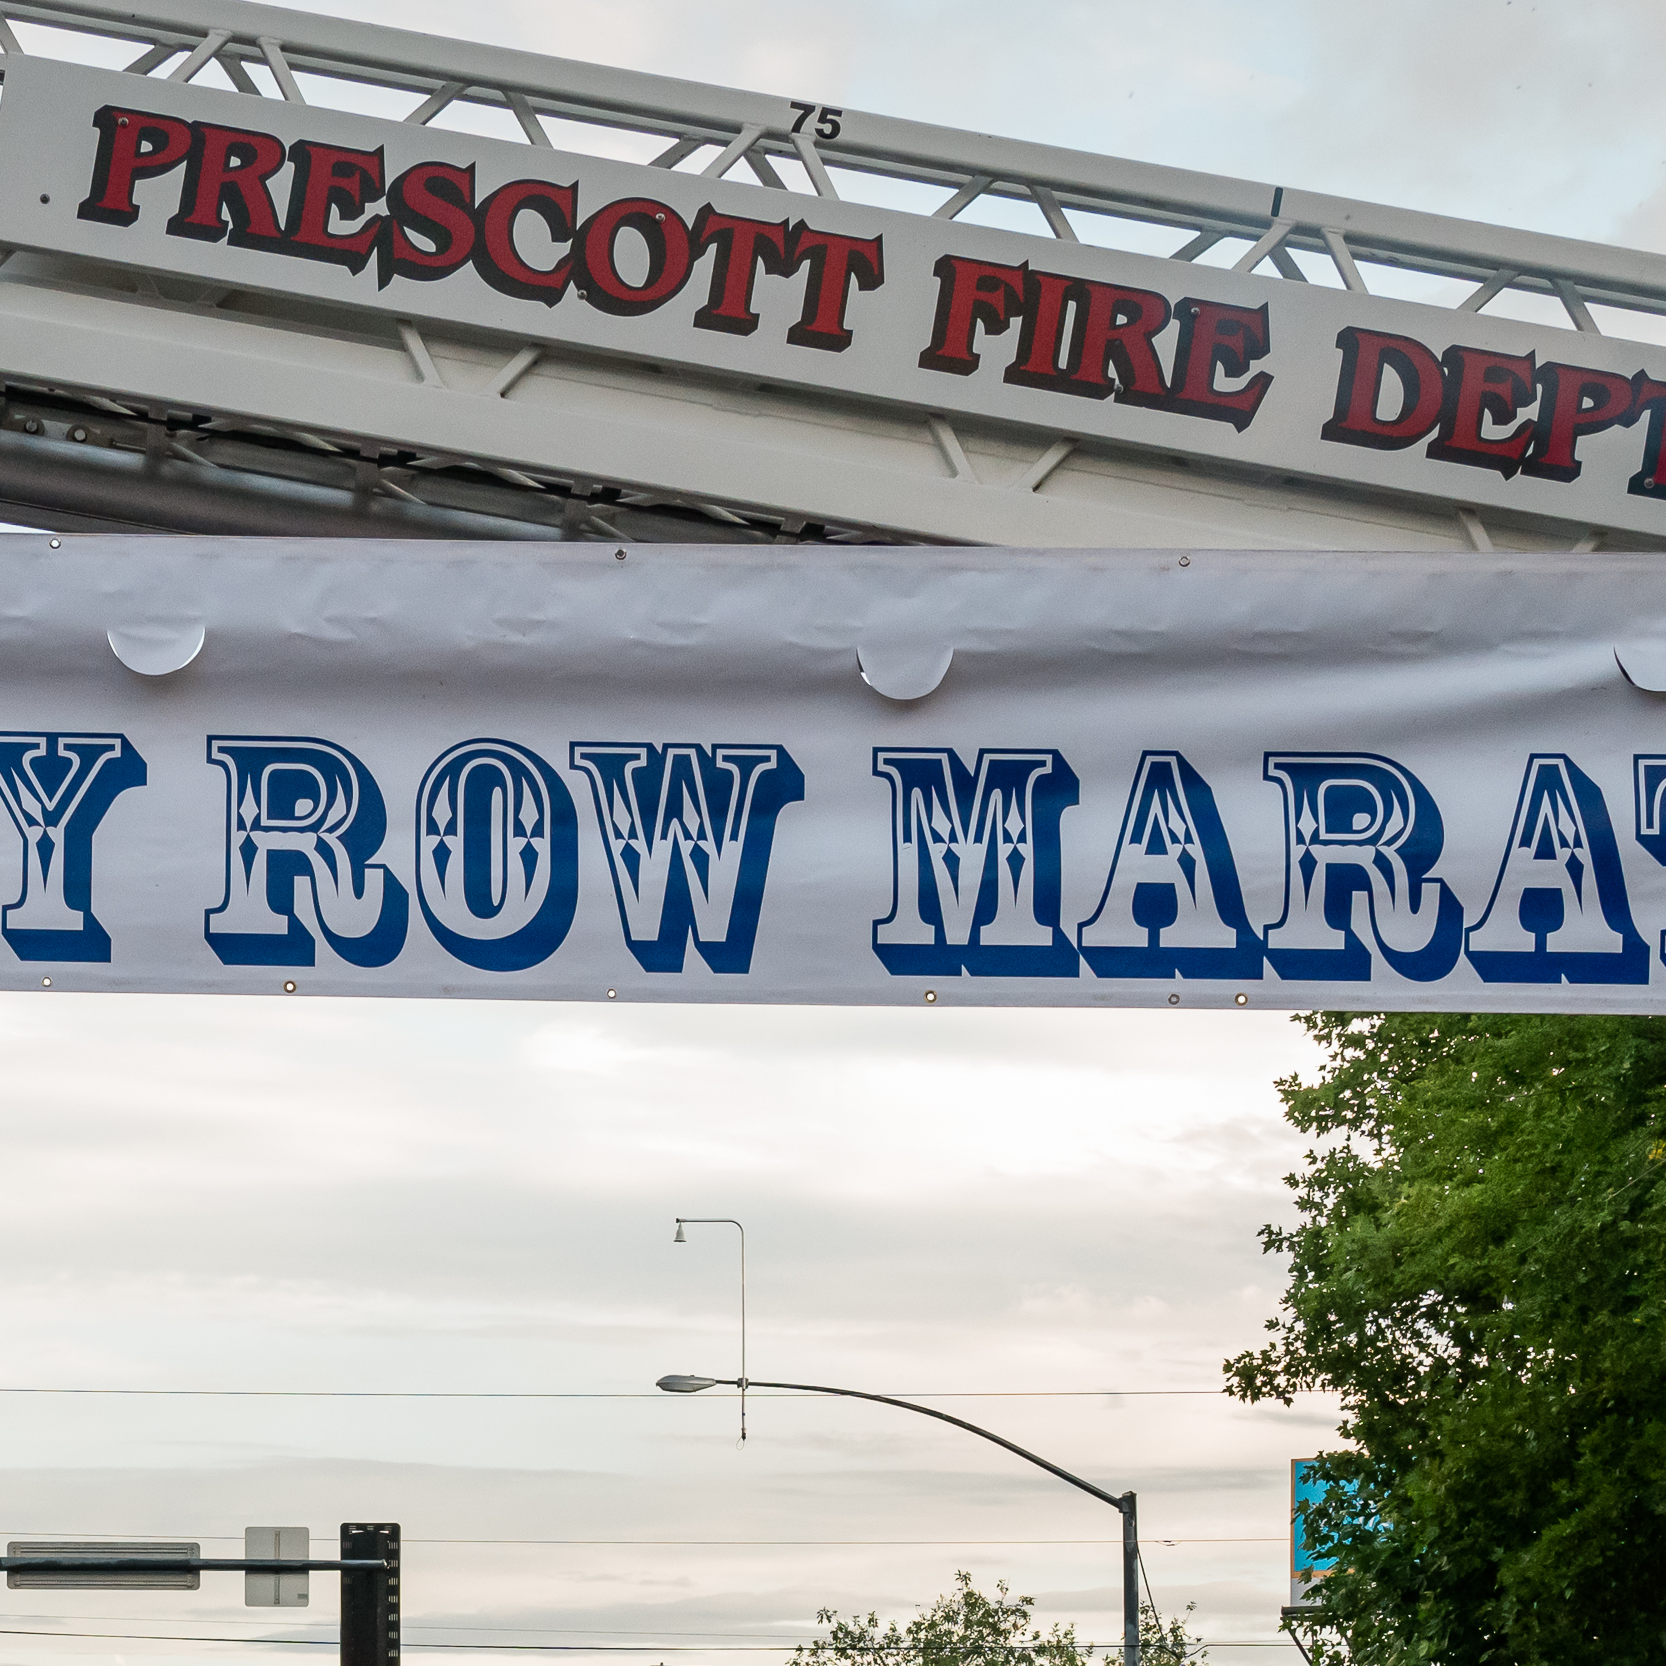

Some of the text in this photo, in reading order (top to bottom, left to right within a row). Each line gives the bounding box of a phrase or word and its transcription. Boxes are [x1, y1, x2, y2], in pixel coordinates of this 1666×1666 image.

[788, 100, 844, 142] 75
[76, 103, 886, 353] PRESCOTT
[917, 254, 1274, 434] FIRE
[204, 734, 806, 976] ROW
